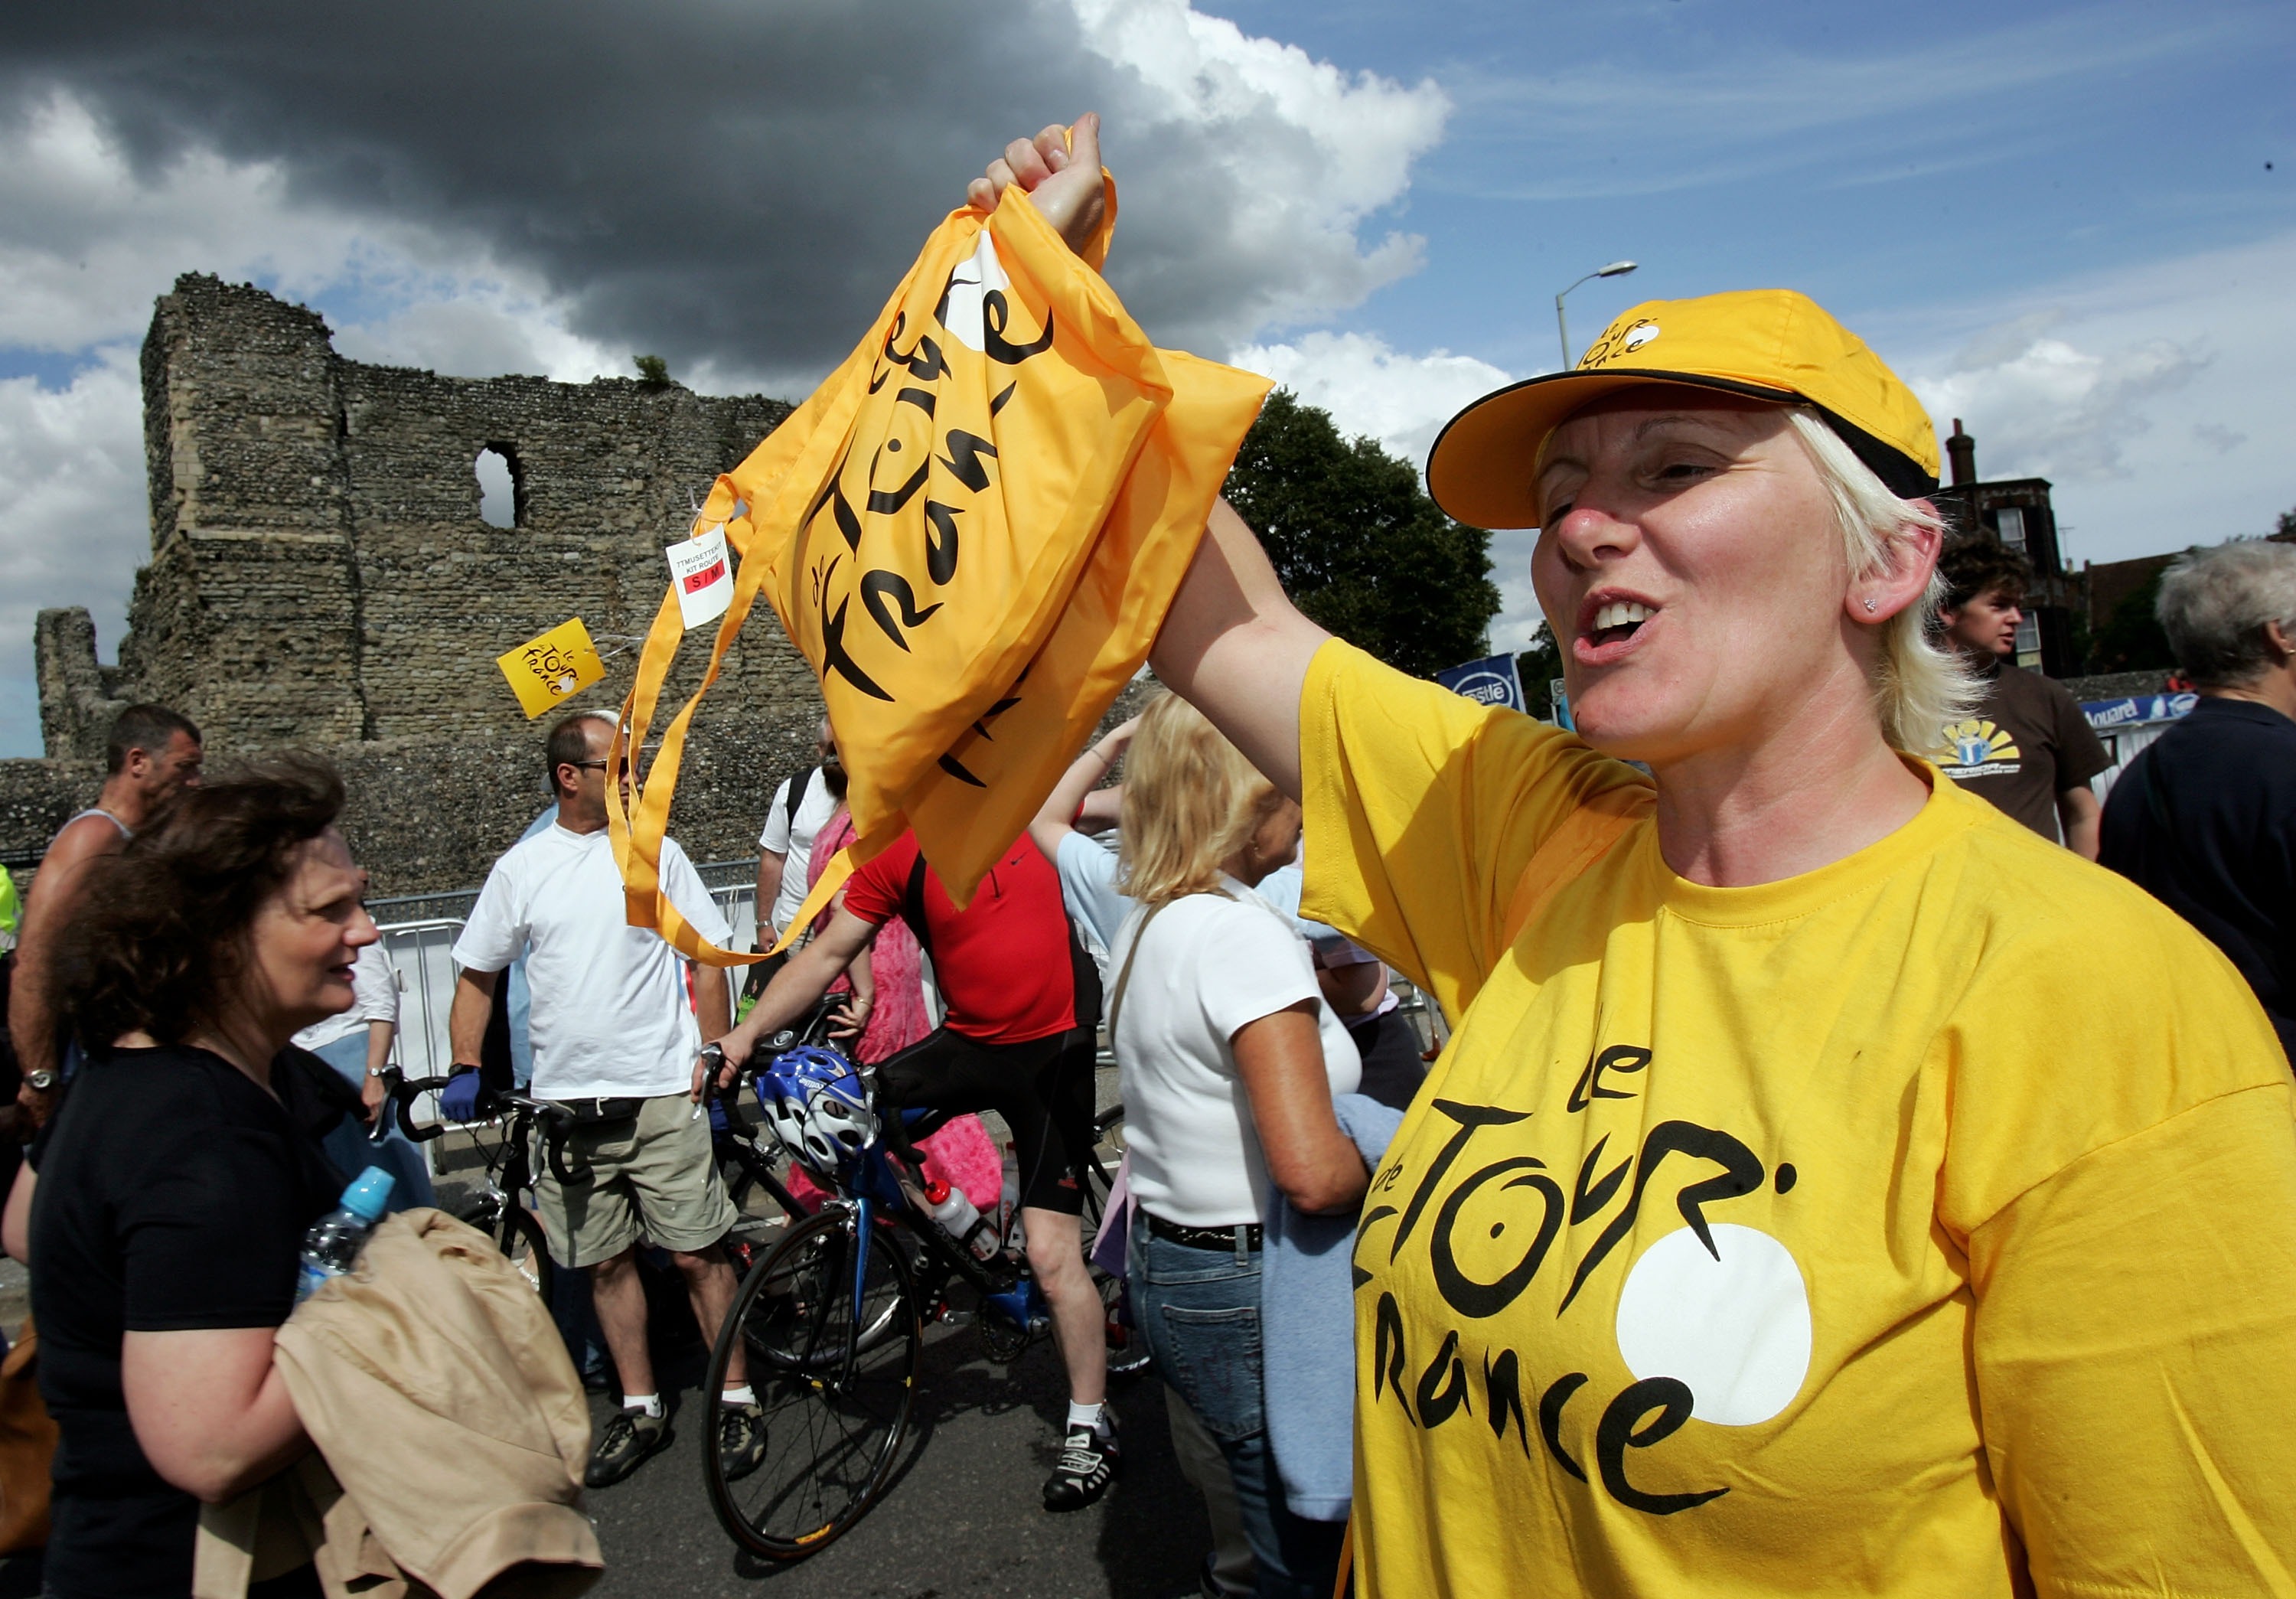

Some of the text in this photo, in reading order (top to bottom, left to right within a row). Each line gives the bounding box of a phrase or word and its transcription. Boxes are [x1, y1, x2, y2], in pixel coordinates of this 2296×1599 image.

[686, 553, 719, 574] KIT ROUTE
[692, 576, 701, 588] S
[711, 566, 720, 579] M
[1567, 1002, 1653, 1113] le
[1371, 1153, 1404, 1194] de
